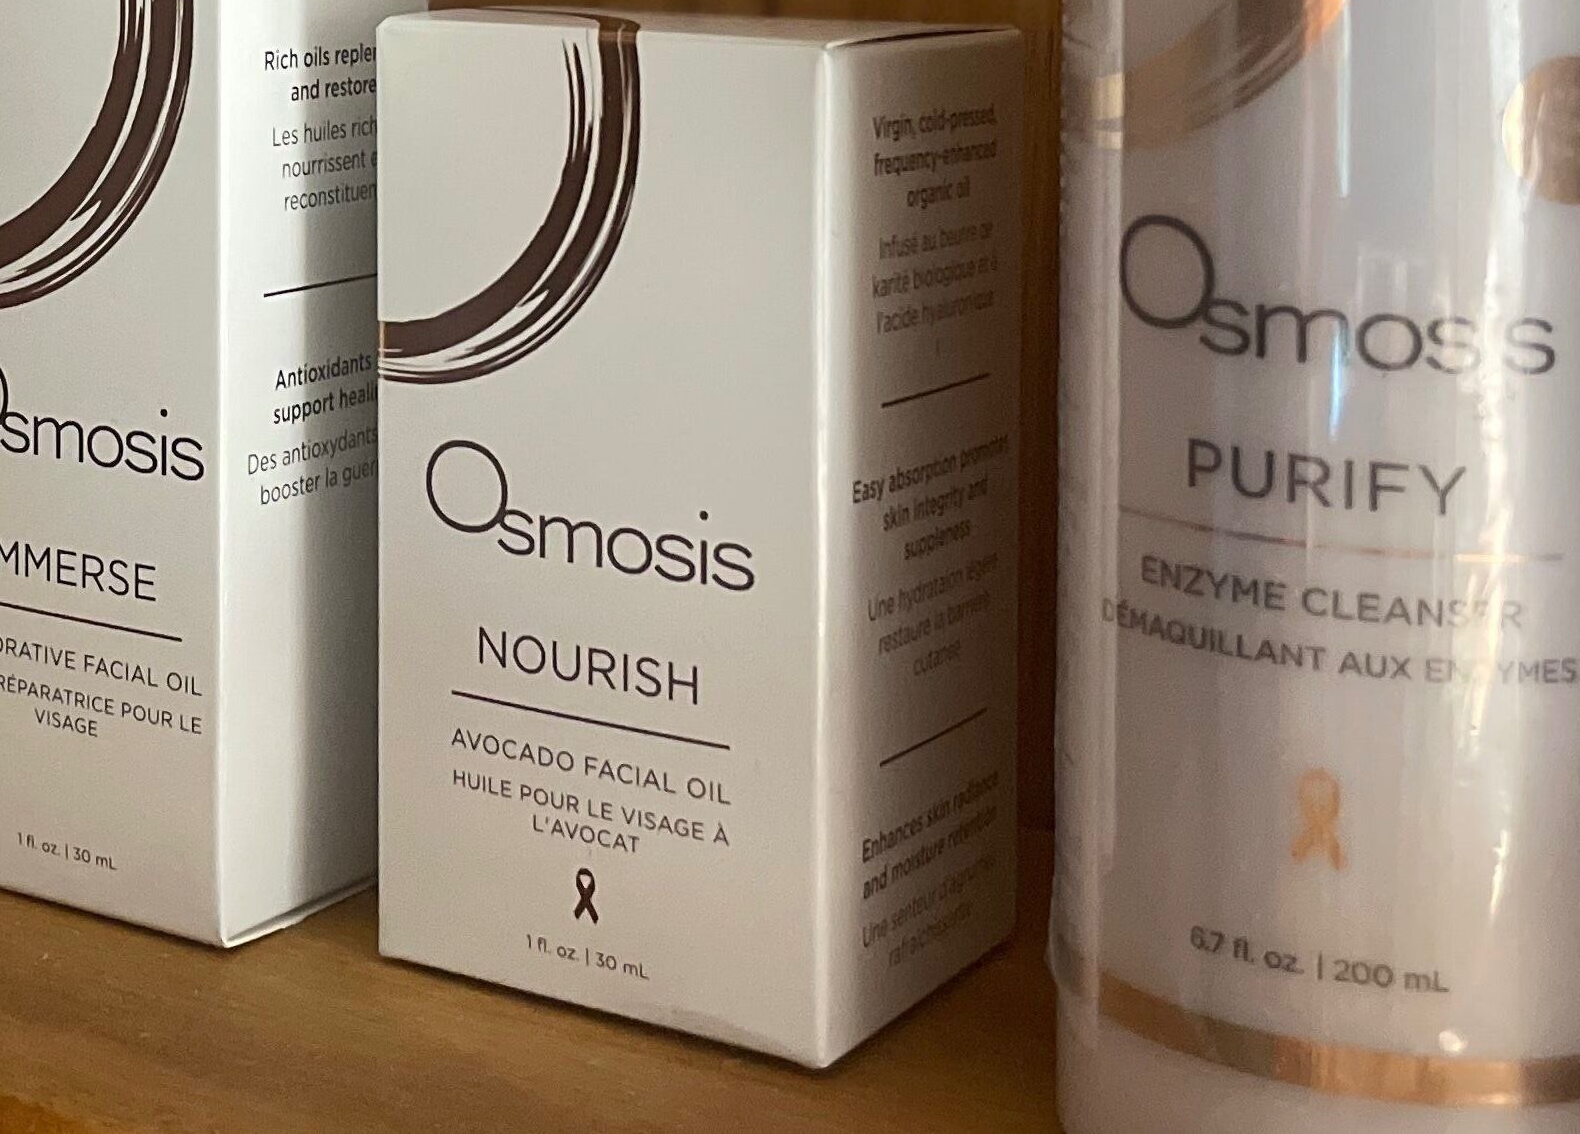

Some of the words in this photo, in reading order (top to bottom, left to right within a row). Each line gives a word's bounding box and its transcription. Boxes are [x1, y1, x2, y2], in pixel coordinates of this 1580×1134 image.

[264, 48, 299, 71] Rich
[303, 46, 330, 67] oils
[291, 78, 320, 101] and
[272, 126, 299, 147] Les
[304, 119, 347, 143] huiles
[282, 151, 366, 179] nourrissent
[1120, 214, 1556, 376] Osmoss
[275, 352, 371, 391] Antioxidants
[273, 391, 335, 425] support
[247, 453, 277, 475] Des
[282, 426, 378, 466] antioxydants
[260, 474, 320, 506] booster
[325, 467, 338, 488] la
[852, 478, 885, 504] Easy
[889, 454, 956, 493] absorption
[1188, 437, 1467, 516] PURIFY
[426, 440, 755, 591] Osmosis
[883, 504, 910, 532] skin
[914, 486, 965, 520] integrity
[1141, 555, 1287, 611] ENZYME
[868, 596, 895, 621] Une
[1101, 598, 1326, 671] DÉMAQUILLANT
[1338, 651, 1412, 681] AUX
[1425, 657, 1578, 684] ENYMES
[83, 654, 158, 688] FACIAL
[167, 671, 202, 697] OIL
[477, 626, 699, 705] NOURISH
[35, 708, 98, 738] VISAGE
[121, 701, 173, 729] POUR
[179, 715, 202, 735] LE
[451, 727, 574, 772] AVOCADO
[584, 756, 676, 794] FACIAL
[687, 777, 731, 805] OIL
[453, 770, 512, 798] HUILE
[520, 784, 579, 814] POUR
[588, 799, 613, 821] LE
[621, 807, 705, 840] VISAGE
[713, 823, 729, 846] À
[533, 815, 640, 853] L'AVOCAT
[862, 815, 923, 863] Enhances
[927, 798, 950, 827] skin
[73, 847, 91, 863] 30
[95, 855, 118, 870] mL
[863, 862, 888, 899] and
[596, 951, 617, 970] 30
[623, 963, 650, 980] mL
[1332, 958, 1393, 988] 200
[1403, 970, 1449, 993] mL
